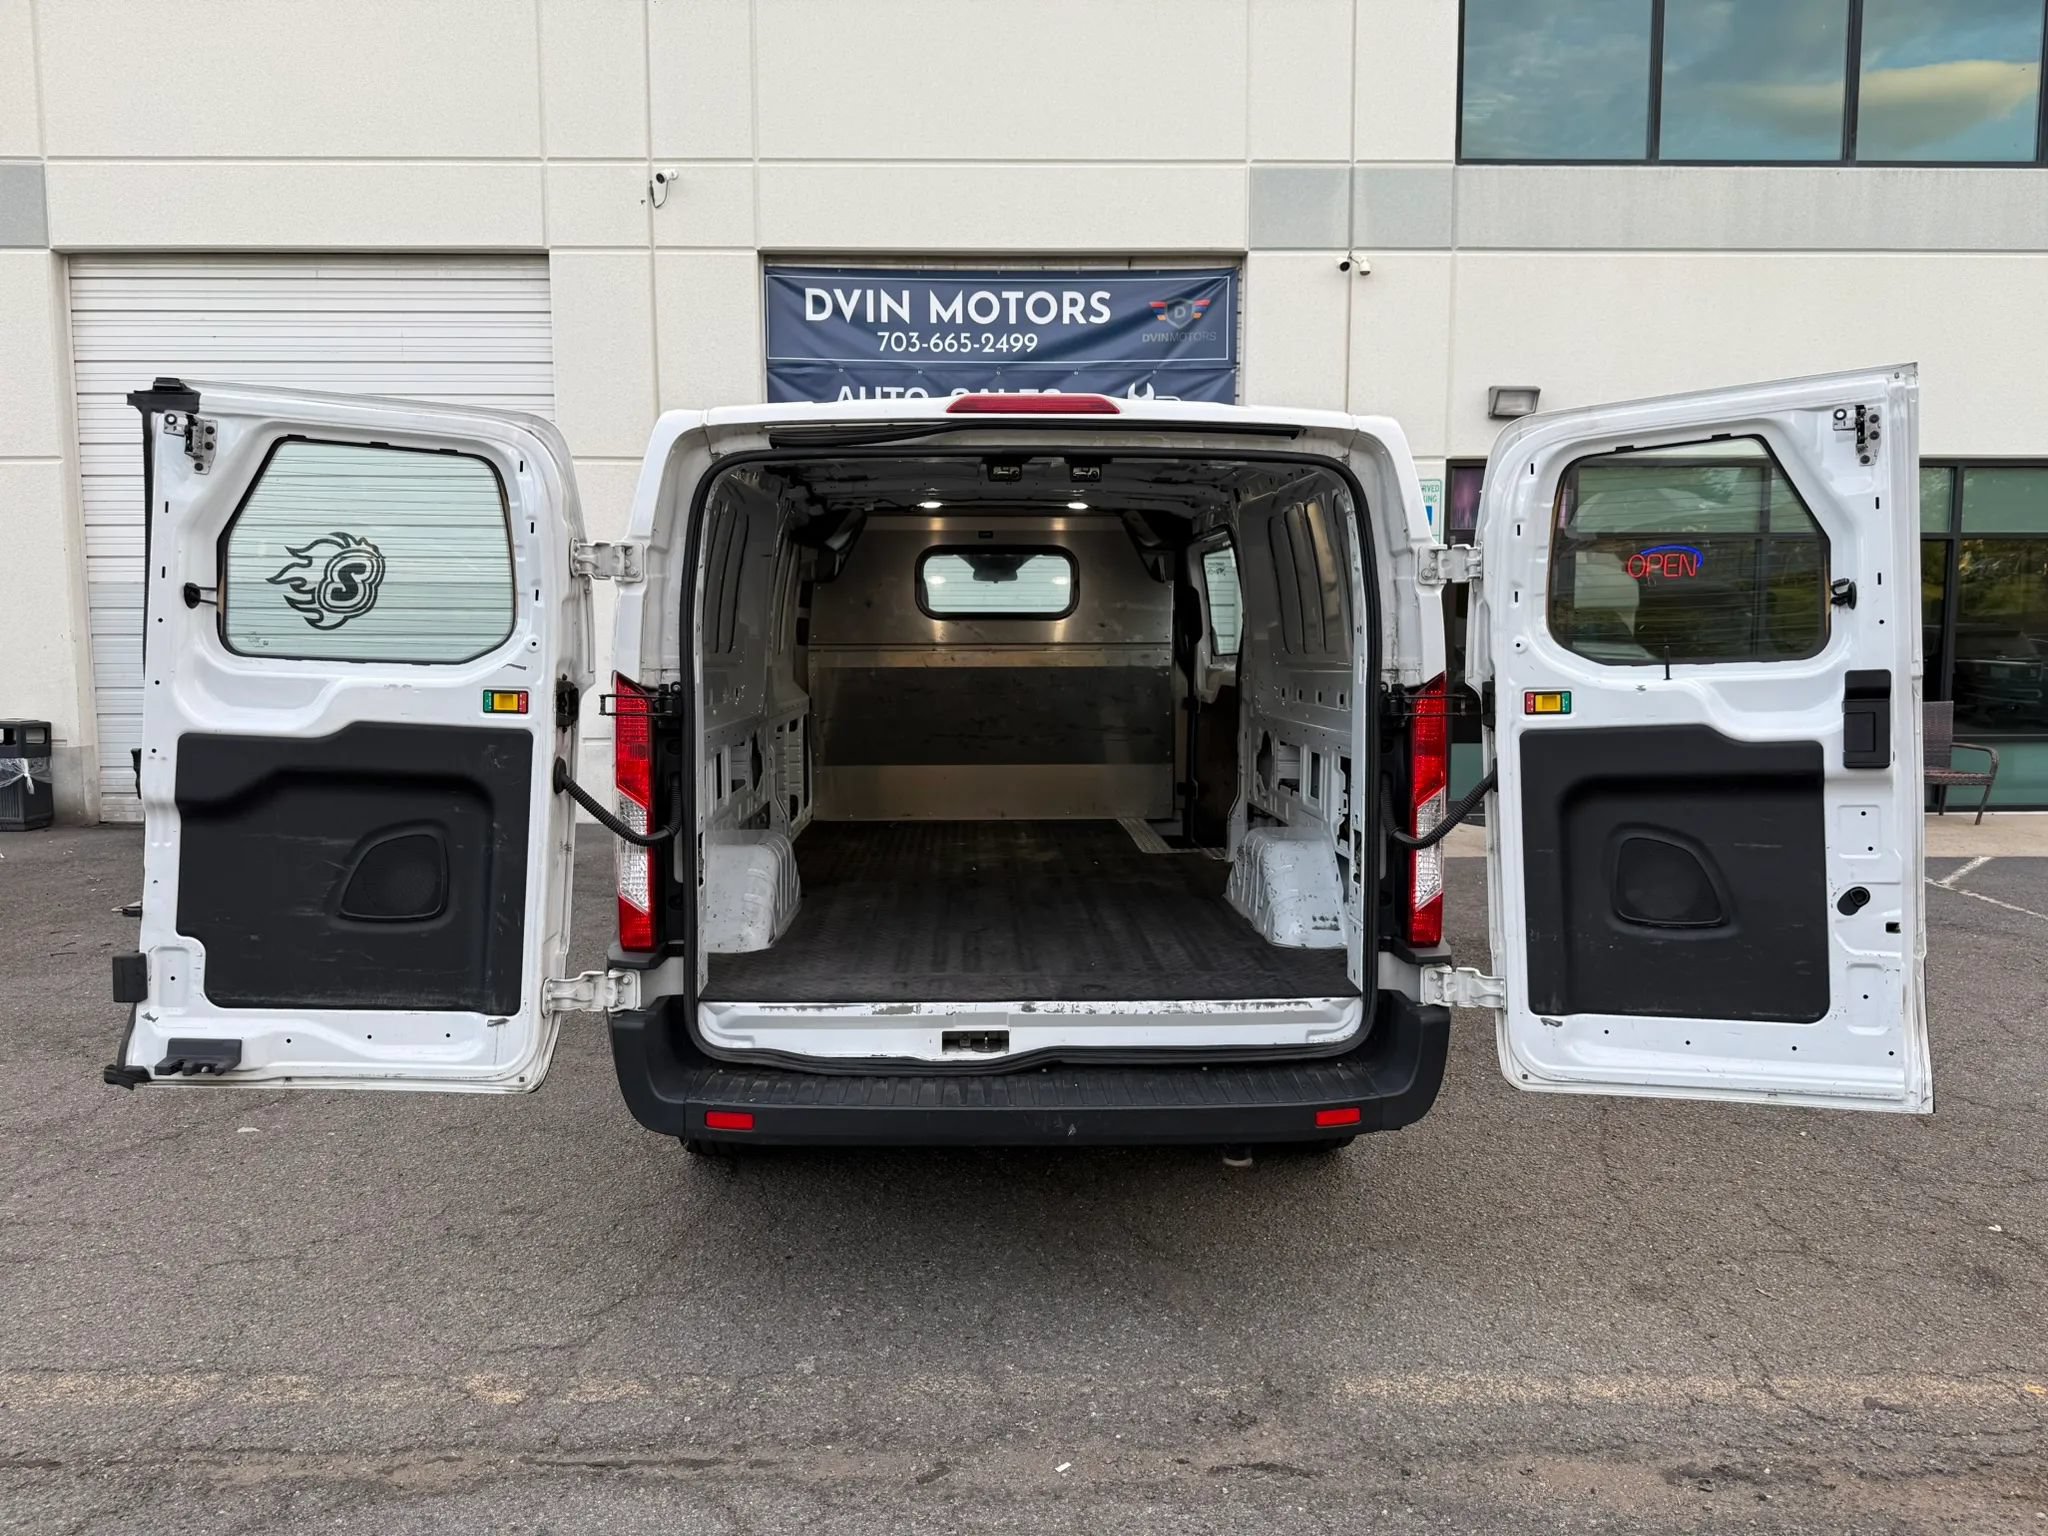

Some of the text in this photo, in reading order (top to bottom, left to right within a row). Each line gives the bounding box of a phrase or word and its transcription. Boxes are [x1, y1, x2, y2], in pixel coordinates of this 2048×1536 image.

[804, 287, 1112, 326] DVIN MOTORS
[877, 331, 1039, 353] 703-665-2499
[1627, 553, 1698, 578] OPEN
